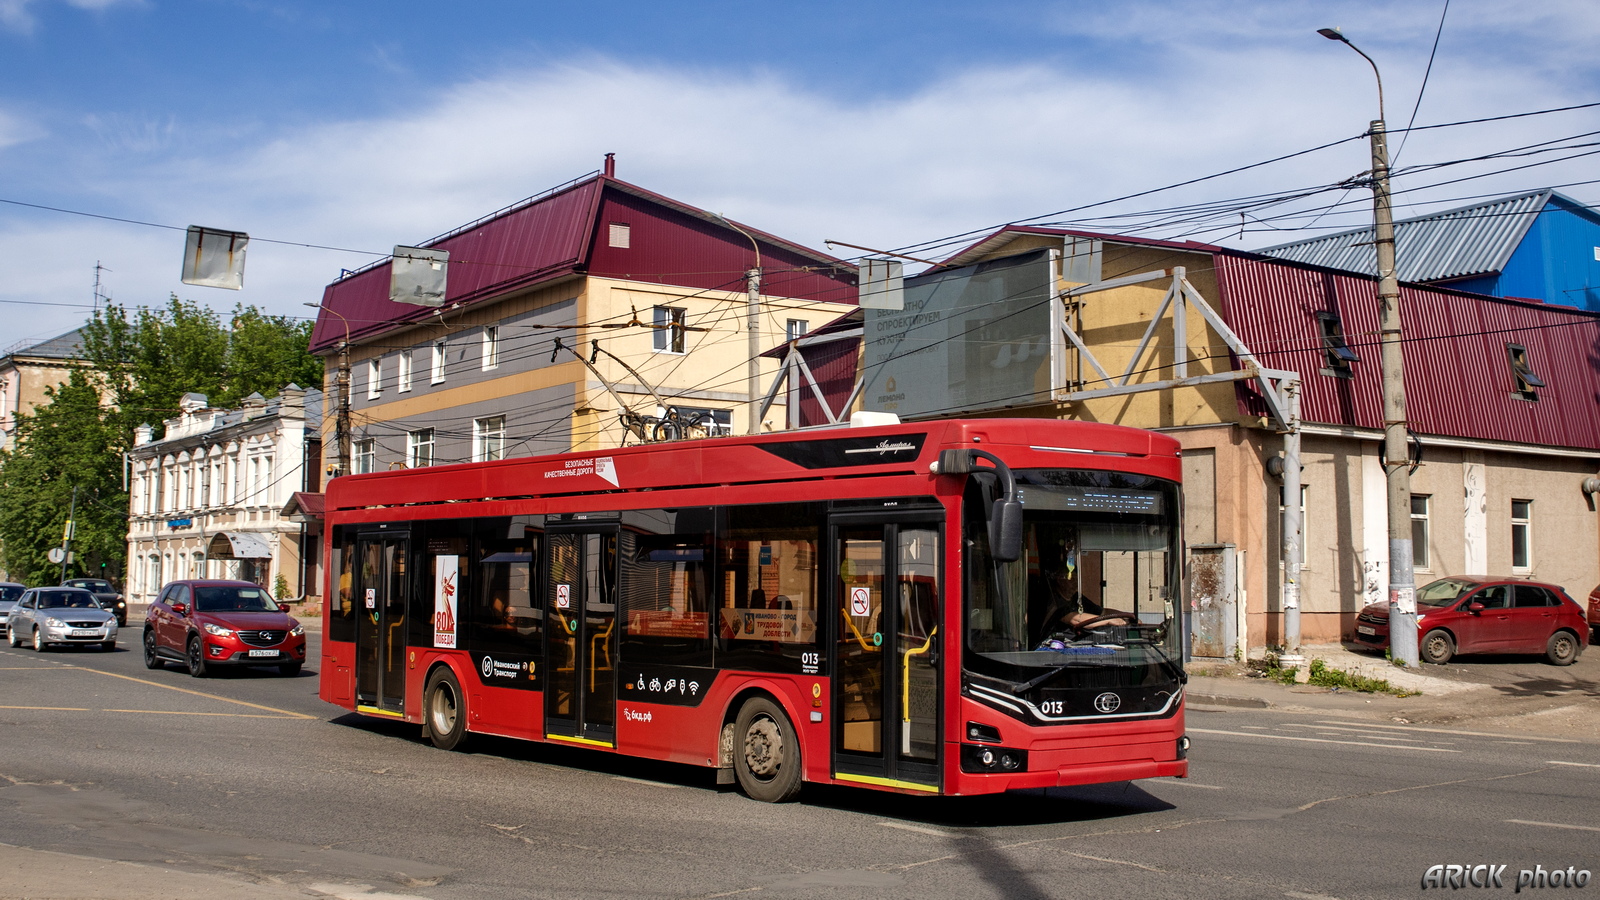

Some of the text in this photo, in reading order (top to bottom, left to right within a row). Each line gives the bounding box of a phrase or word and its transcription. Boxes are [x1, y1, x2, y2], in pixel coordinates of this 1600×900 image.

[877, 300, 924, 318] БЕСАТНО
[877, 311, 941, 332] СПРОЕКТИРУЕМ
[565, 459, 594, 468] БЕЗОПАСНЫЕ
[544, 467, 594, 478] КАЧЕСТВЕННЫЕ ДОРОГИ
[436, 612, 446, 630] 80
[631, 614, 642, 634] 4
[757, 621, 783, 629] ТРУДОВОЙ
[436, 634, 455, 646] ПОБЕДА!
[494, 660, 520, 669] Ивановский
[801, 652, 819, 665] 013
[494, 668, 517, 679] Транспорт
[1041, 701, 1063, 714] 013
[631, 710, 653, 723] бкд.рф
